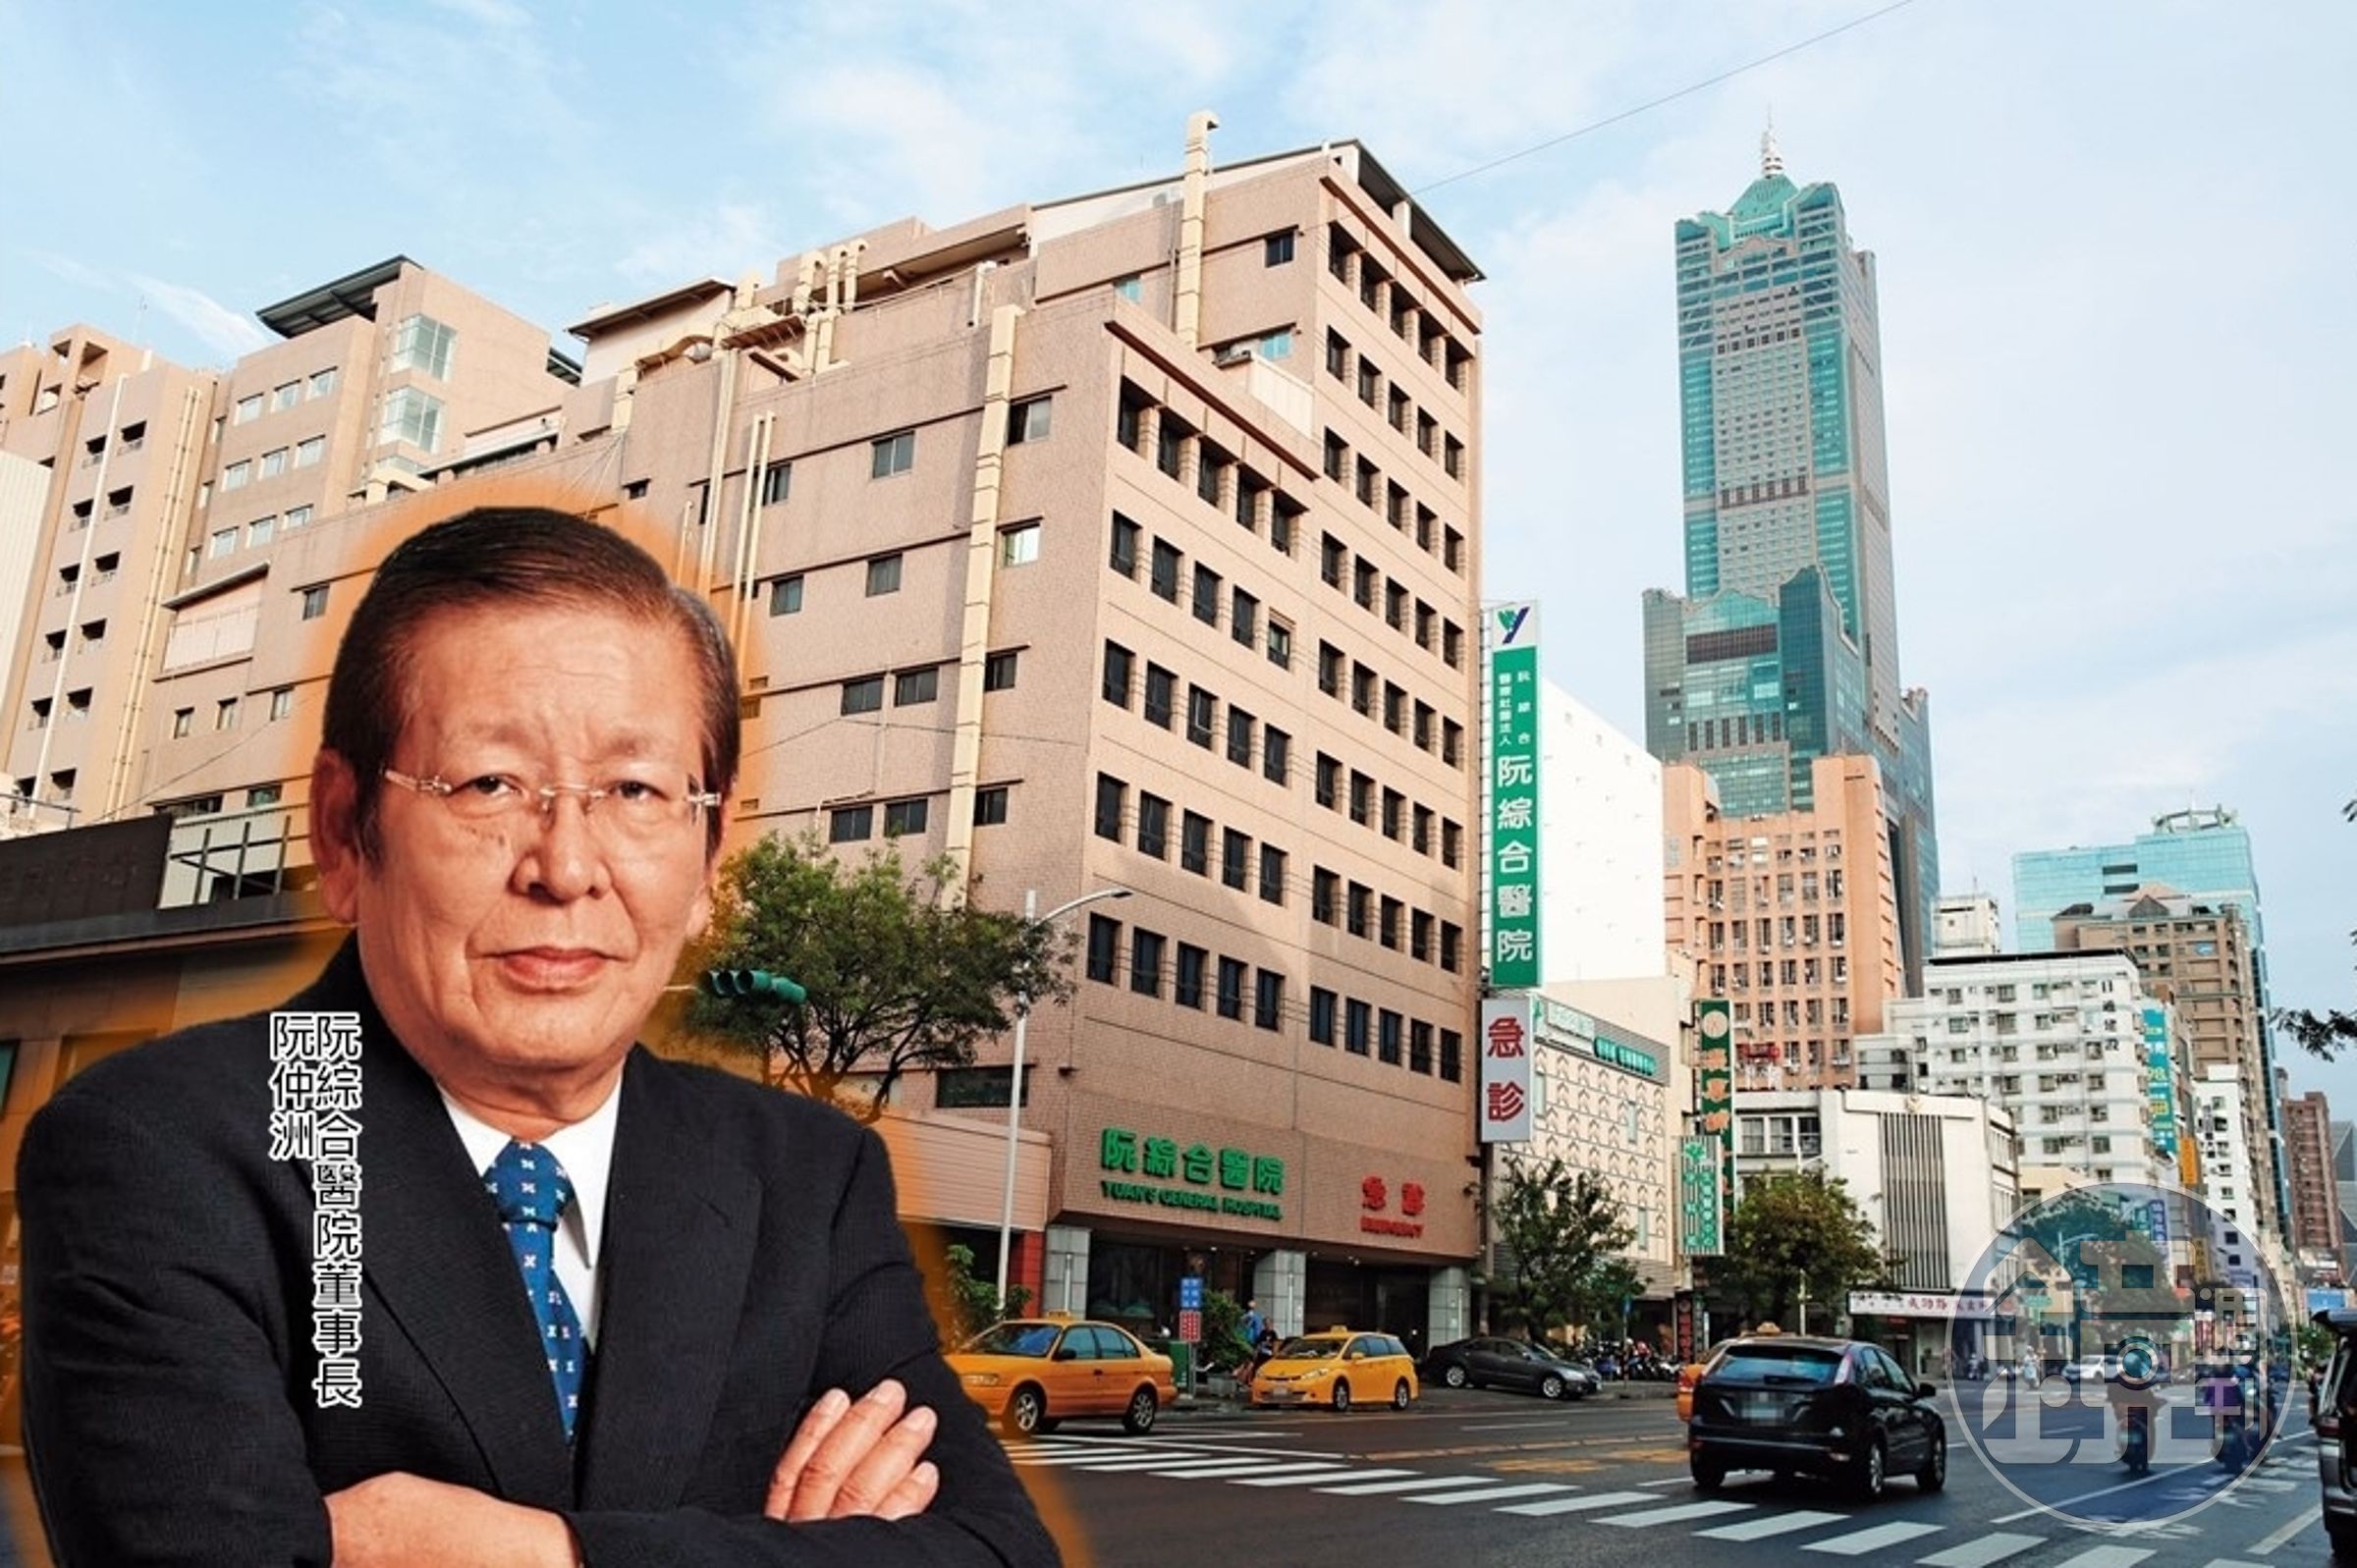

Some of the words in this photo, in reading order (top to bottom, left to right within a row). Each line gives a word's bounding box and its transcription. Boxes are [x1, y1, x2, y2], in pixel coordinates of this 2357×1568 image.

[1496, 754, 1534, 963] 阮綜合醫院
[1486, 1016, 1526, 1124] 急診
[1101, 1127, 1285, 1195] 阮綜合醫院
